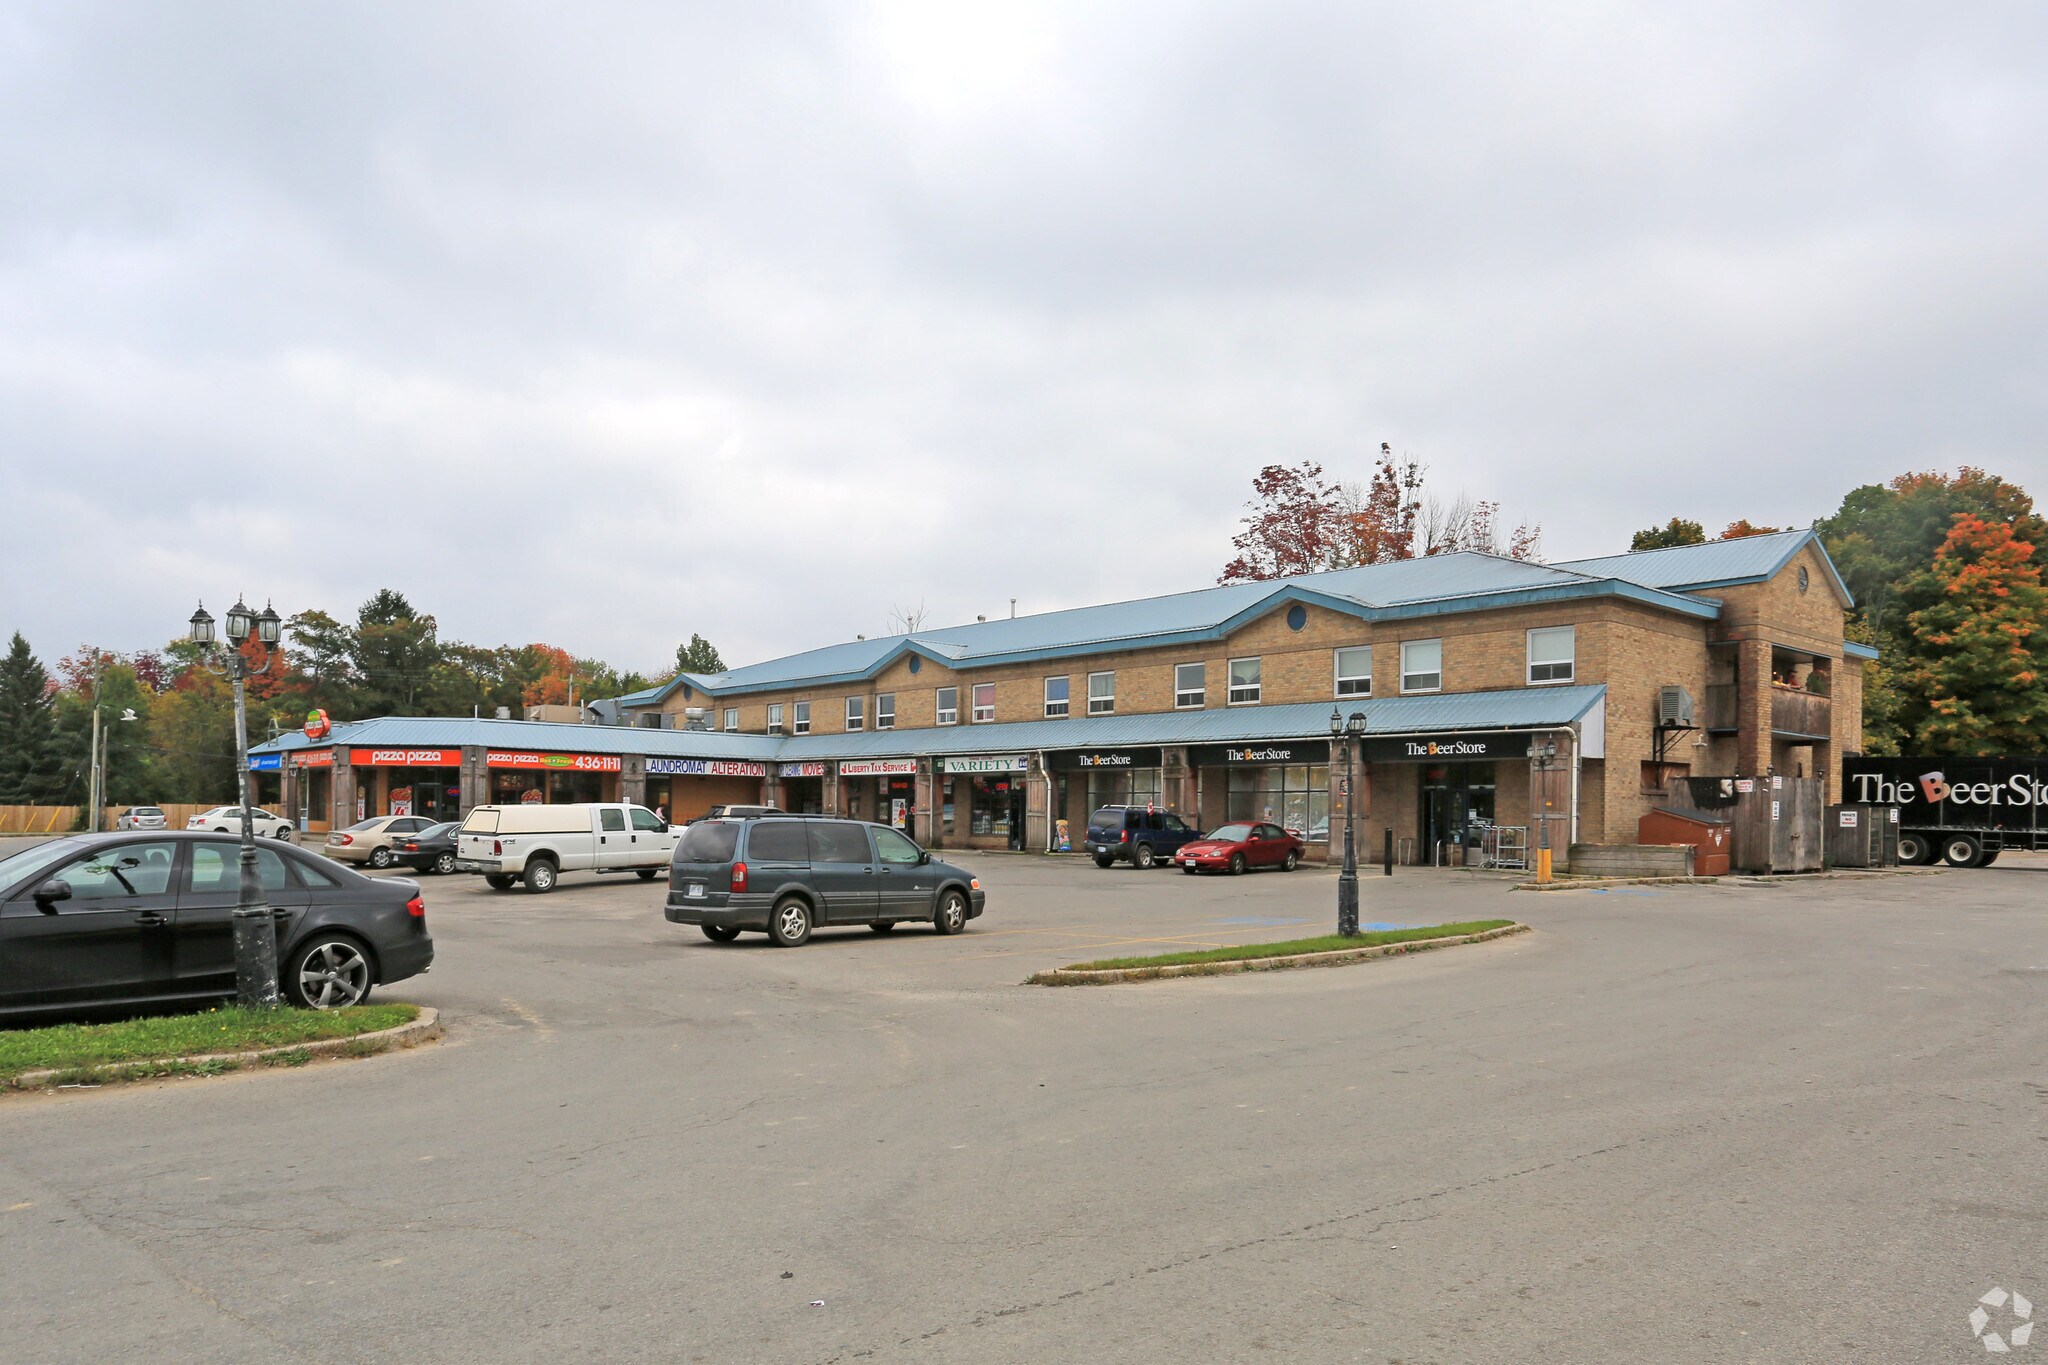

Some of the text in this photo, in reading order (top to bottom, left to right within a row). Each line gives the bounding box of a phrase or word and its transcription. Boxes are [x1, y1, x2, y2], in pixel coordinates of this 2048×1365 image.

[1227, 749, 1244, 761] The
[1406, 742, 1427, 755] The
[372, 750, 442, 765] pizza pizza
[487, 753, 512, 763] pizza
[513, 754, 539, 765] pizza
[1079, 755, 1093, 766] The
[711, 762, 764, 776] ALTERATION
[802, 762, 825, 776] MOVIES
[950, 759, 1014, 772] VARIETY
[1852, 773, 1916, 804] The
